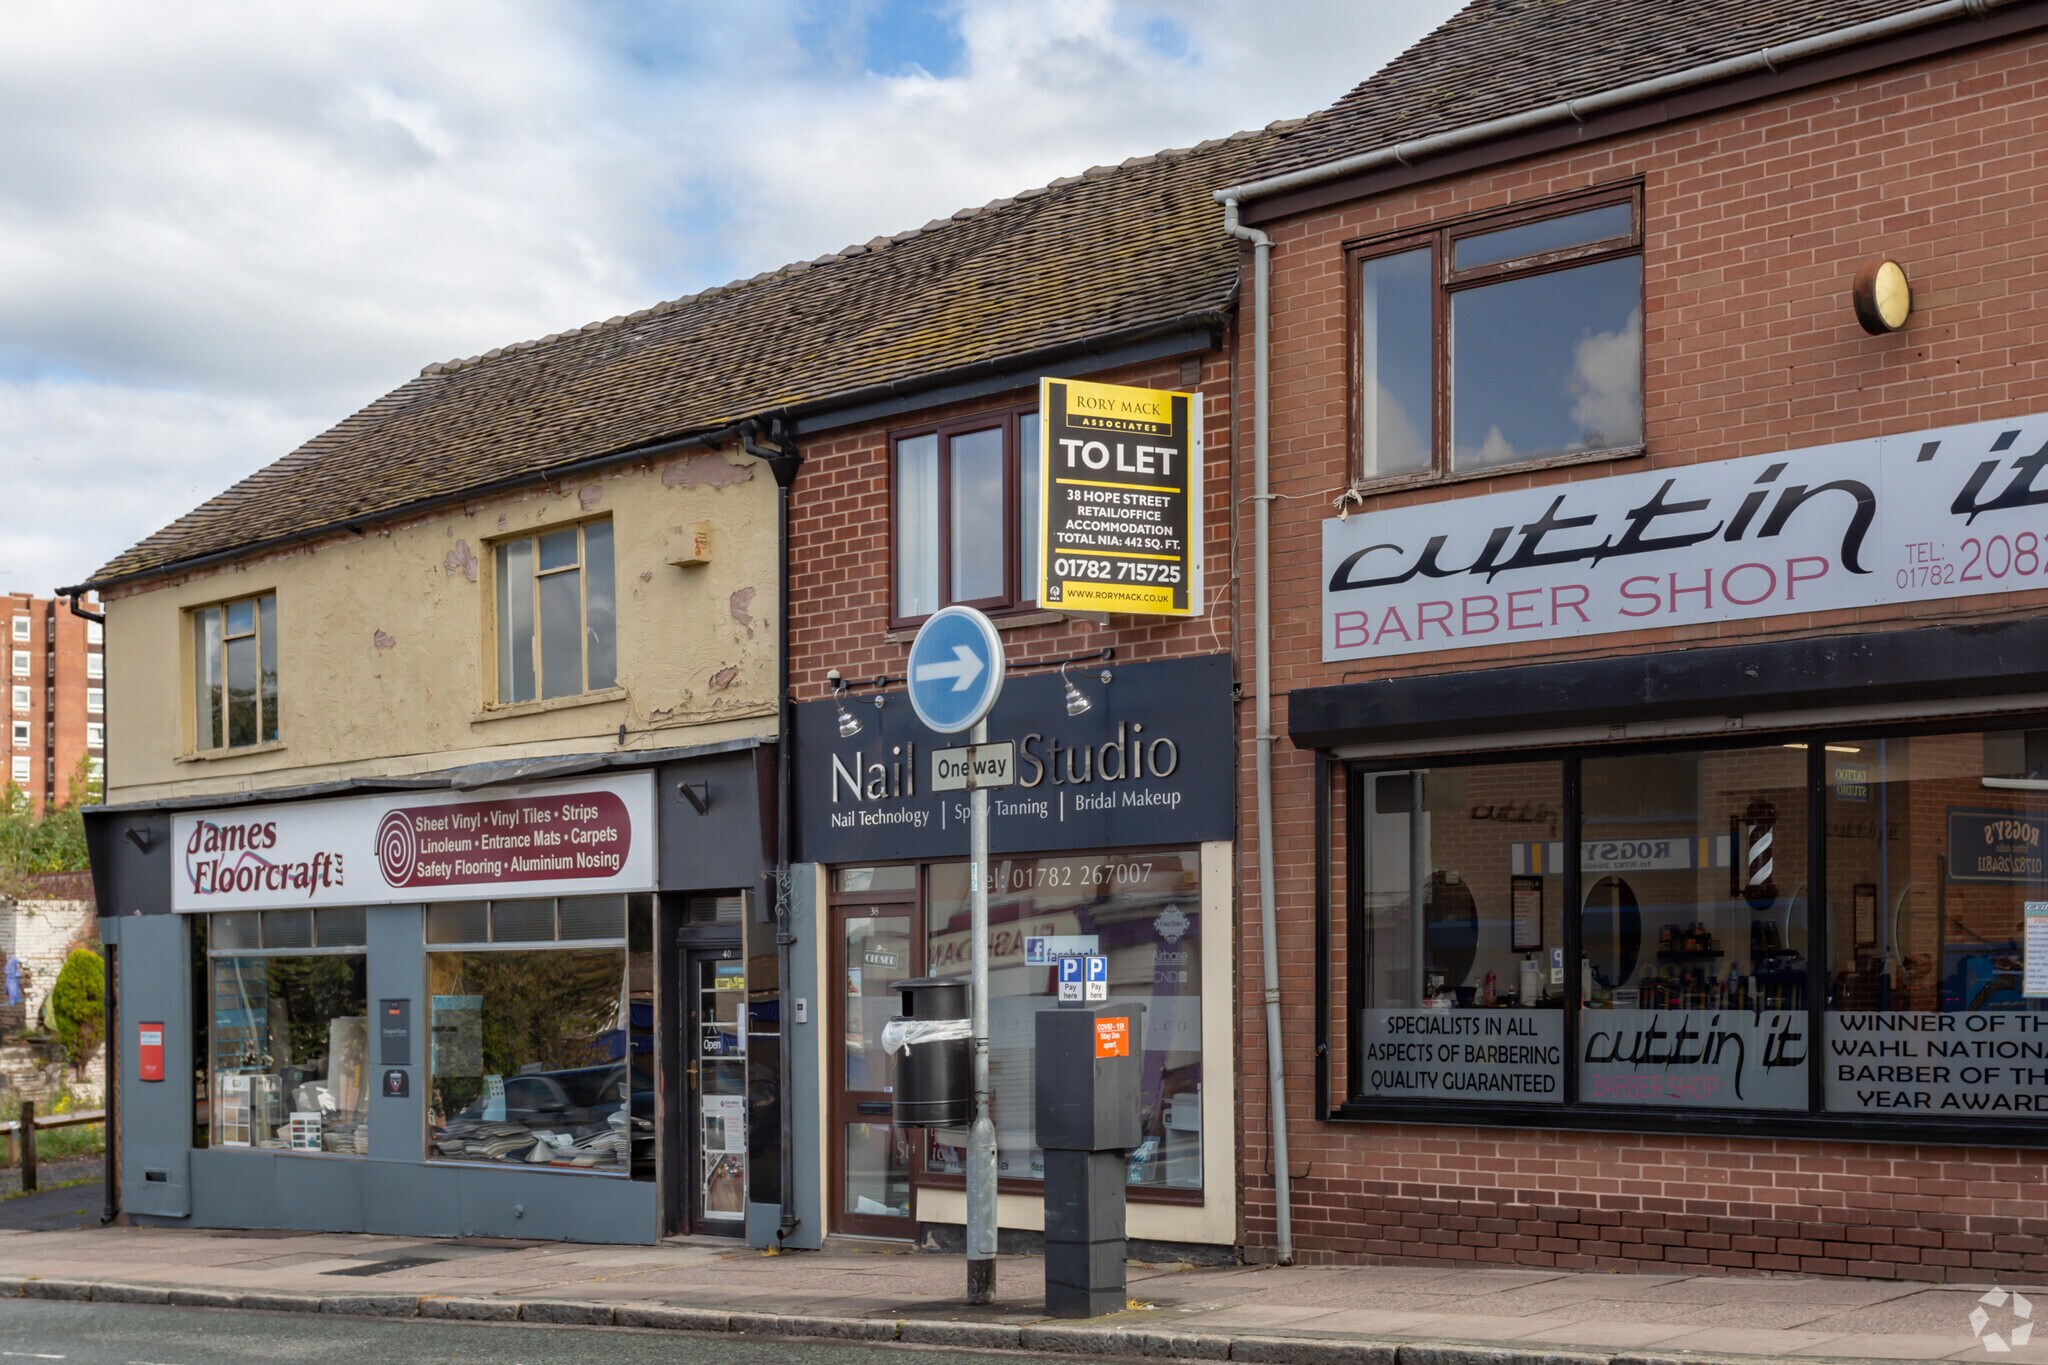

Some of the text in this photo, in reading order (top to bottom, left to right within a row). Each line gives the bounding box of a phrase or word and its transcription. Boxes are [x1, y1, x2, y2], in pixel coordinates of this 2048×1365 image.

[1077, 396, 1161, 416] RORY MACK
[1083, 418, 1158, 432] ASSOCIATES
[1059, 438, 1178, 475] TO LET
[1067, 489, 1170, 508] 38 HOPE STREET
[1077, 506, 1161, 521] RETAIL/OFFICE
[1065, 519, 1173, 536] ACCOMMODATION
[1329, 462, 1877, 593] cuttin
[1057, 532, 1181, 550] TOTAL NIA: 442 SQ. FT.
[1896, 531, 2048, 589] 01782 208
[1905, 541, 1945, 564] TEL:
[1054, 558, 1181, 583] 01782 715725
[1067, 589, 1169, 603] WWW.RORYMACK.CO.UK
[1333, 556, 1829, 649] BARBER SHOP
[832, 720, 1178, 803] Nail Studio
[938, 756, 1007, 780] One way
[415, 803, 599, 832] Sheet Vinyl Vinyl Tiles Strips
[831, 811, 855, 828] Nail
[858, 807, 930, 828] Technology
[996, 799, 1048, 820] Tanning
[1076, 791, 1116, 811] Bridal
[1122, 788, 1182, 810] Makeup
[187, 820, 277, 854] James
[420, 826, 618, 854] Linoleum Entrance Mats Carpets
[193, 851, 333, 899] Floorcraft
[417, 851, 620, 880] Safety Flooring Aluminium Nosing
[986, 863, 1153, 890] el: 01782 267007
[870, 906, 880, 916] 38
[722, 950, 732, 959] 40
[865, 953, 896, 965] CLOSED
[1152, 950, 1188, 961] Airbase
[1064, 959, 1078, 981] P
[1091, 959, 1103, 981] P
[1153, 971, 1178, 983] CND
[1064, 992, 1078, 1000] here
[1065, 983, 1077, 992] Pay
[1091, 983, 1102, 991] Pay
[1388, 1016, 1538, 1036] SPECIALISTS IN ALL
[1840, 1014, 1956, 1032] WINNER
[1965, 1014, 2006, 1033] OF
[703, 1039, 722, 1052] Open
[1367, 1043, 1560, 1065] ASPECTS OF BARBERING
[1832, 1040, 2048, 1059] WAHL NATION
[1584, 1013, 1745, 1101] cuttin
[1371, 1070, 1556, 1093] QUALITY GUARANTEED
[1838, 1064, 1951, 1083] BARBER
[1960, 1066, 2001, 1084] OF
[1592, 1074, 1721, 1100] BARBER SHOP
[1857, 1090, 1932, 1108] YEAR
